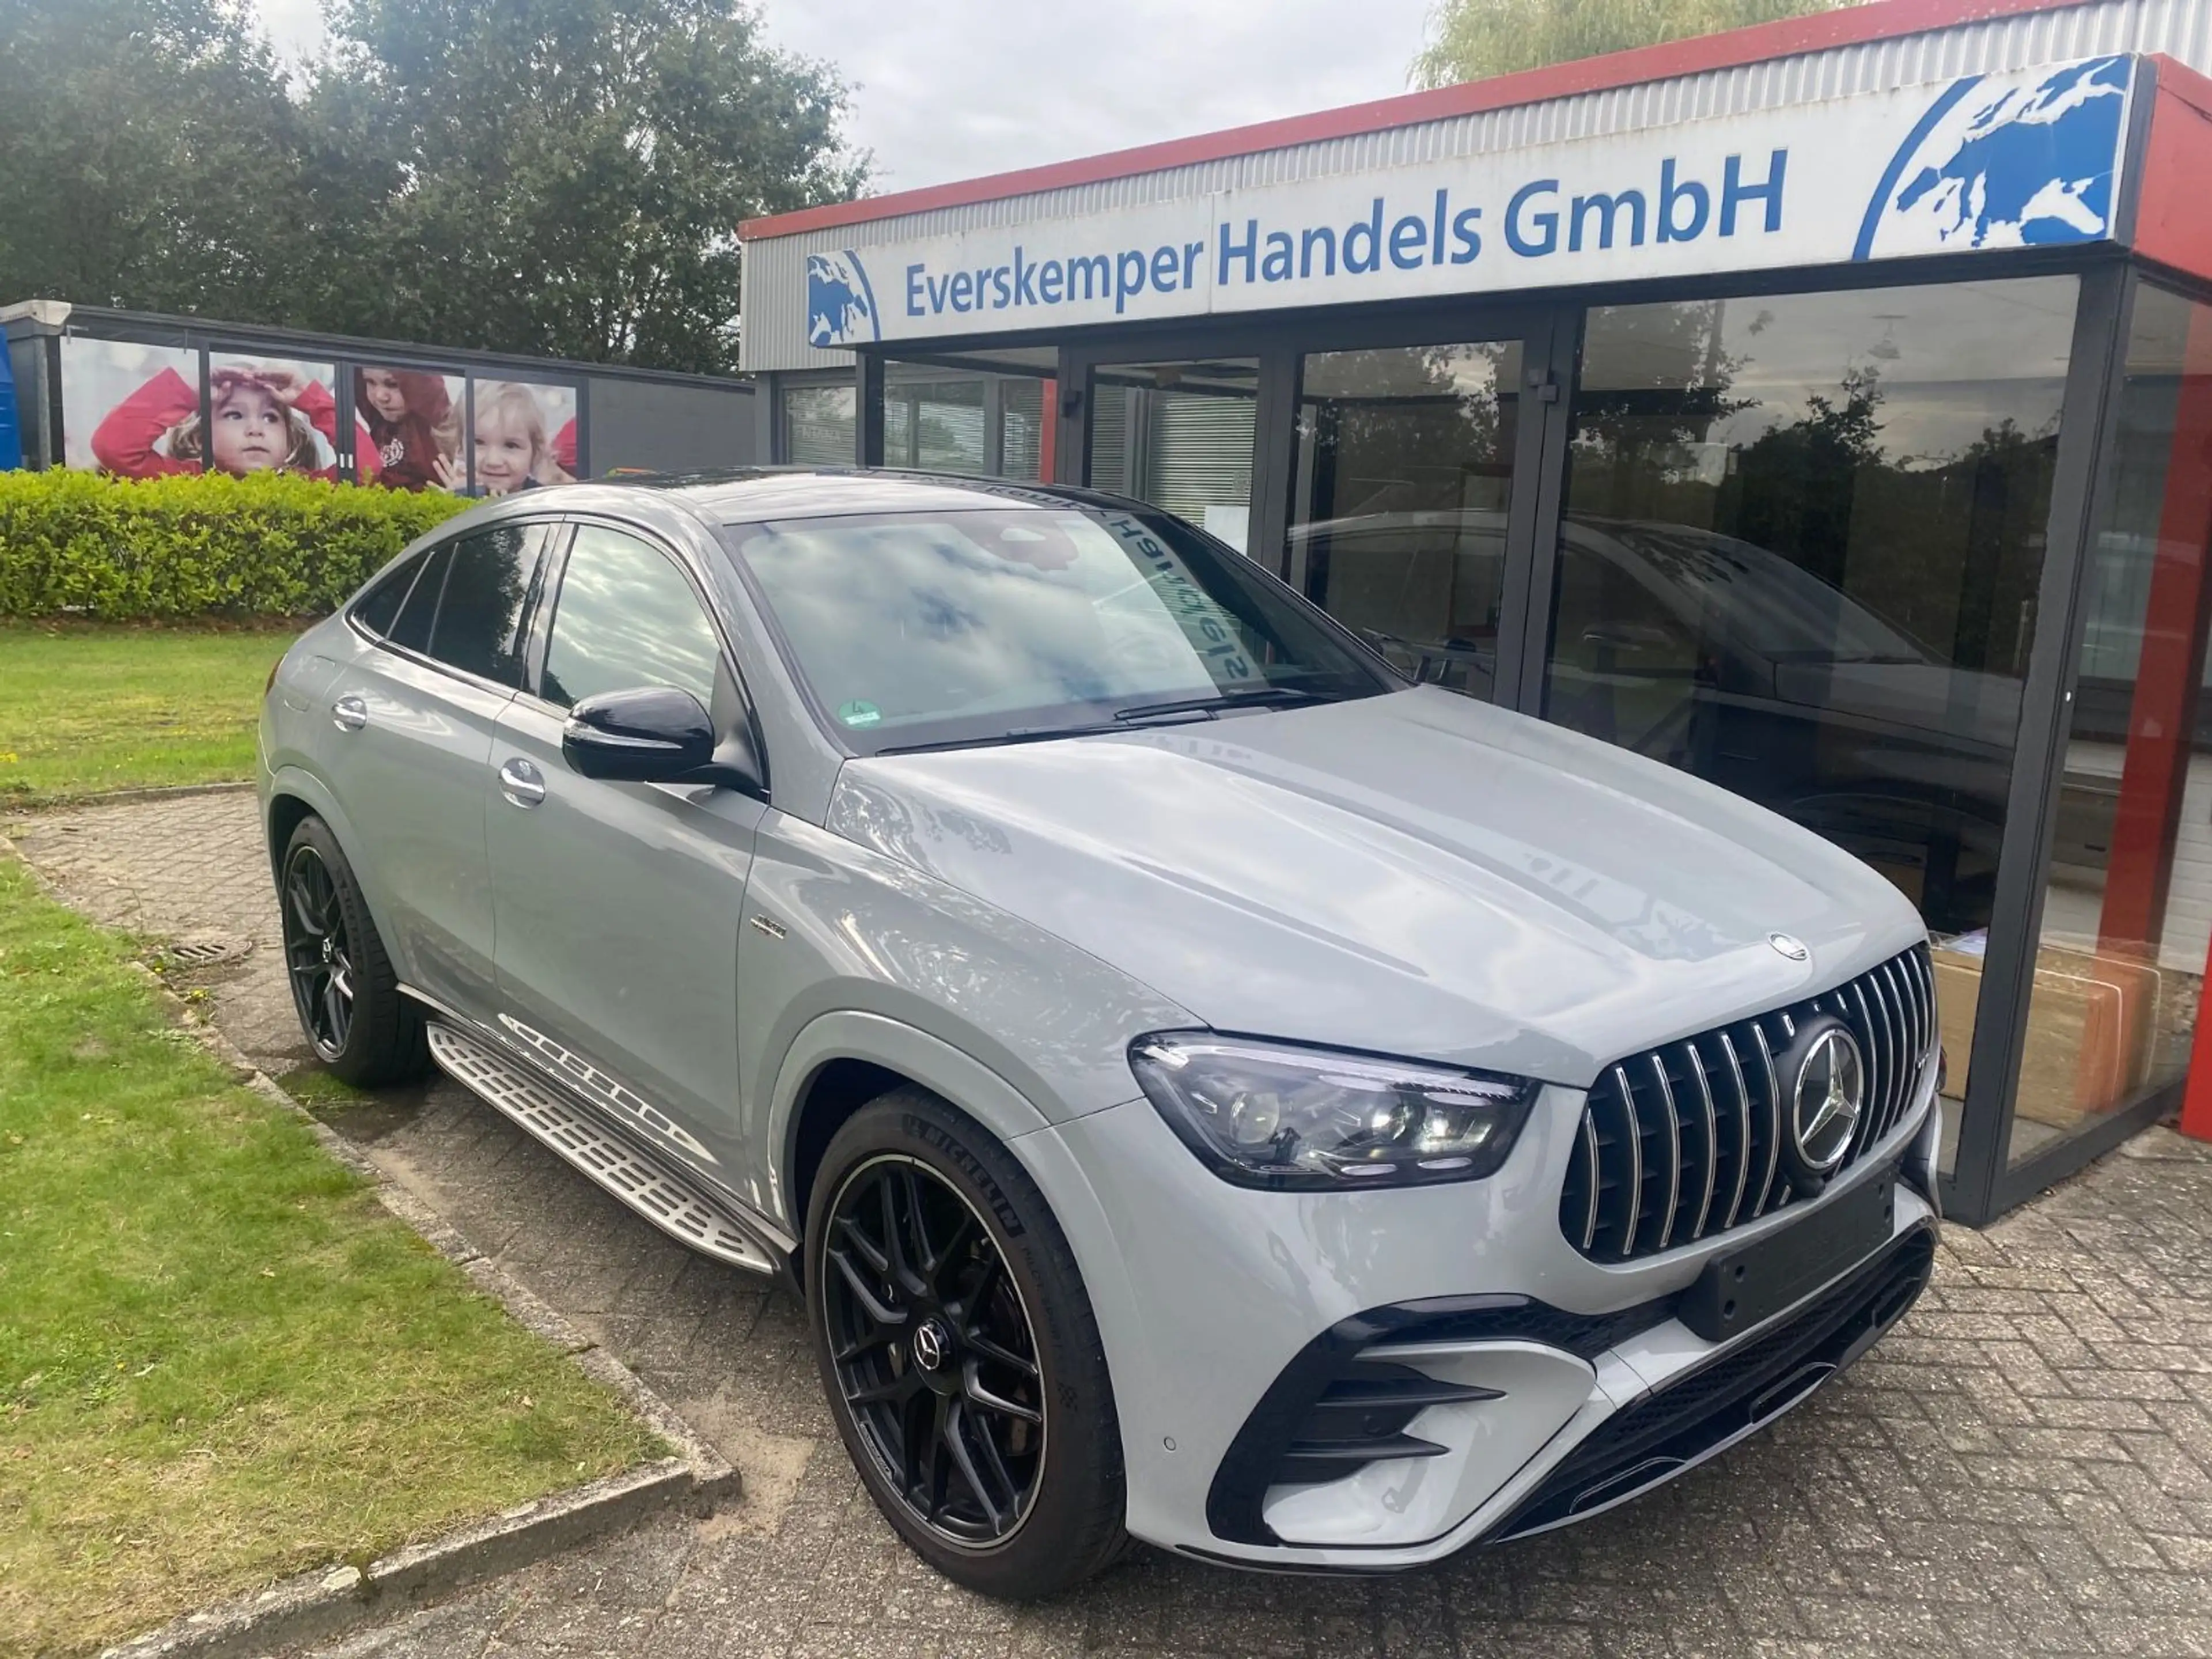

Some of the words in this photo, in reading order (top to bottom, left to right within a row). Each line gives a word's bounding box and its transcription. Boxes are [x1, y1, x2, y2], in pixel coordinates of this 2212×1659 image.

[906, 240, 1204, 316] Everskemper
[1217, 190, 1483, 286] Handels
[1503, 149, 1787, 257] GmbH
[924, 1126, 1020, 1233] MICHELIN
